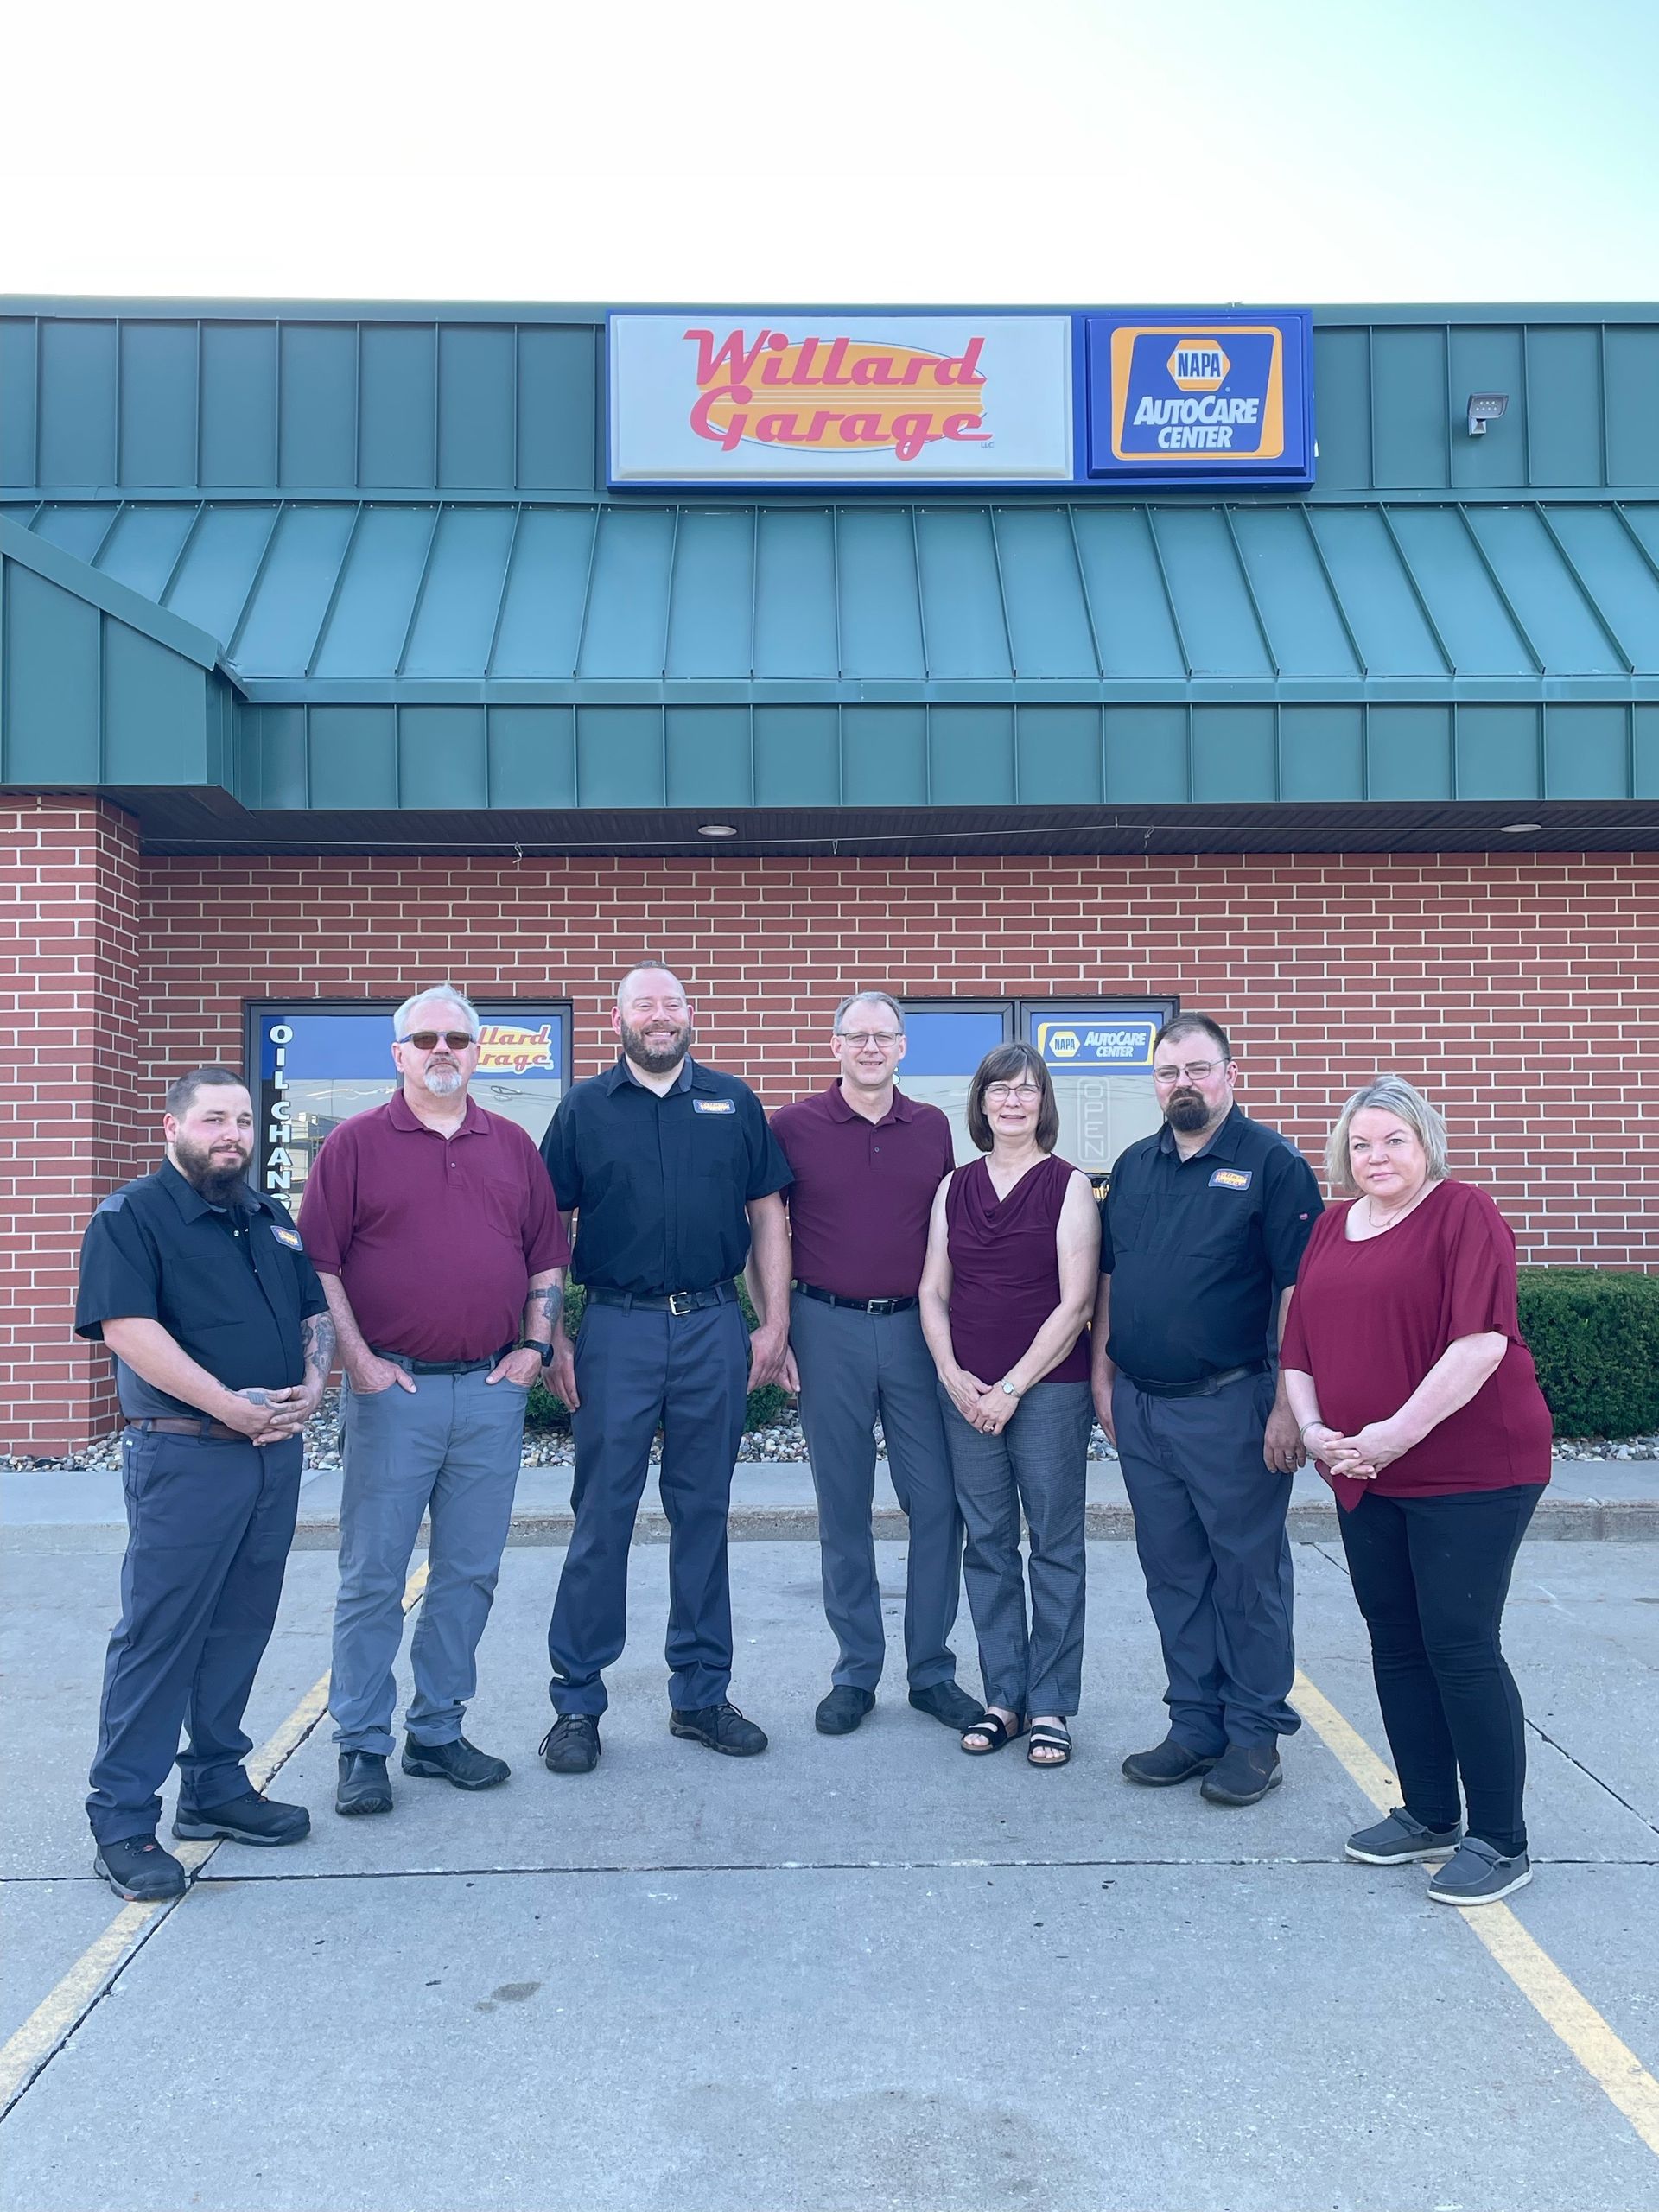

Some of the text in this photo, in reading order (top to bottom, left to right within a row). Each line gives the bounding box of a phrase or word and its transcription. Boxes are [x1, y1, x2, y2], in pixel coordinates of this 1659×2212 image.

[683, 329, 988, 385] Willard
[1177, 353, 1221, 378] NAPA
[690, 385, 993, 461] Garage
[1157, 425, 1234, 448] CENTER
[477, 1027, 549, 1045] llard
[1054, 1038, 1076, 1051] NAPA
[269, 1024, 294, 1090] OIL
[476, 1046, 550, 1072] rage
[1096, 1046, 1134, 1058] CENTER
[1084, 1084, 1104, 1158] OPEN
